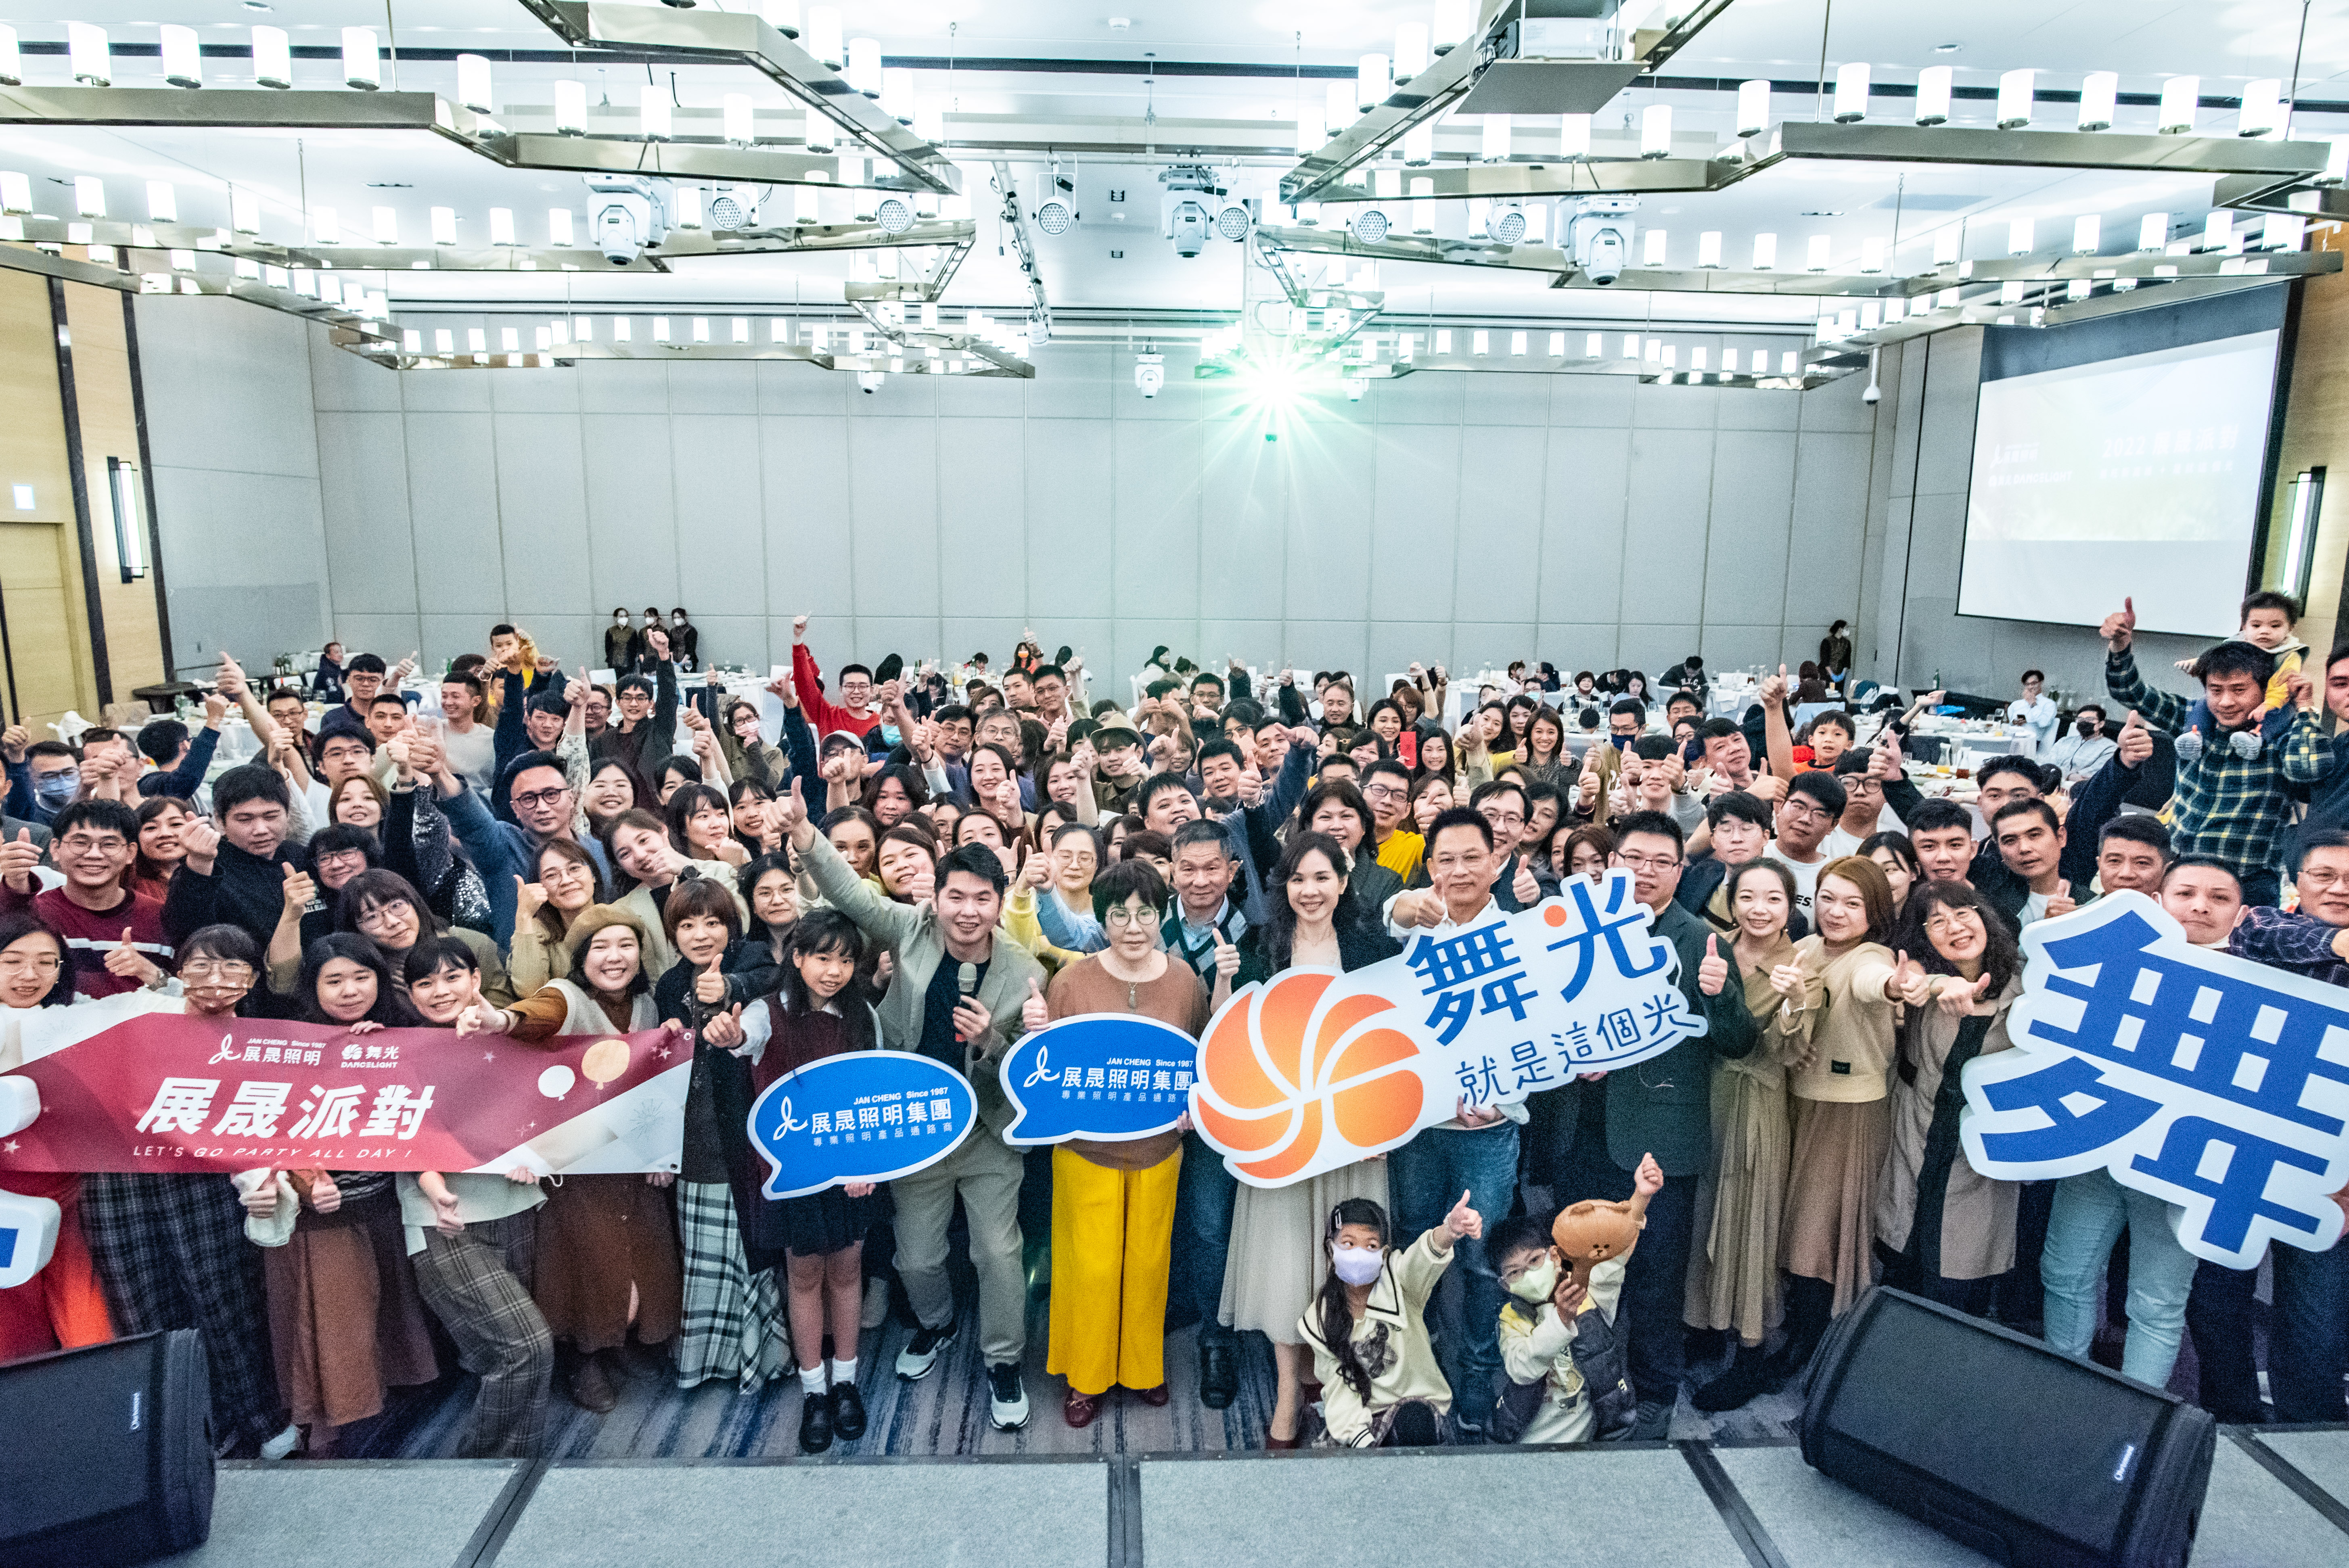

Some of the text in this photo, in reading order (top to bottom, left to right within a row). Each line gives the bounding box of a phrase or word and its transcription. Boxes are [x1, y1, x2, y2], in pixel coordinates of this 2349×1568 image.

[2103, 436, 2146, 457] 2022
[1405, 876, 1668, 1047] 舞光
[243, 1046, 321, 1066] 展晟照明
[365, 1045, 400, 1060] 舞光
[1455, 993, 1700, 1106] 就是這個光
[1062, 1067, 1193, 1091] 展晟照明集團
[853, 1087, 948, 1105] JAN CHENG Since 1987
[136, 1077, 435, 1140] 展晟派對
[812, 1098, 952, 1134] 展晟照明集團
[133, 1146, 184, 1157] LET'S
[194, 1148, 224, 1157] GO
[233, 1148, 302, 1156] PARTY
[309, 1149, 344, 1158] ALL
[356, 1149, 396, 1158] DAY
